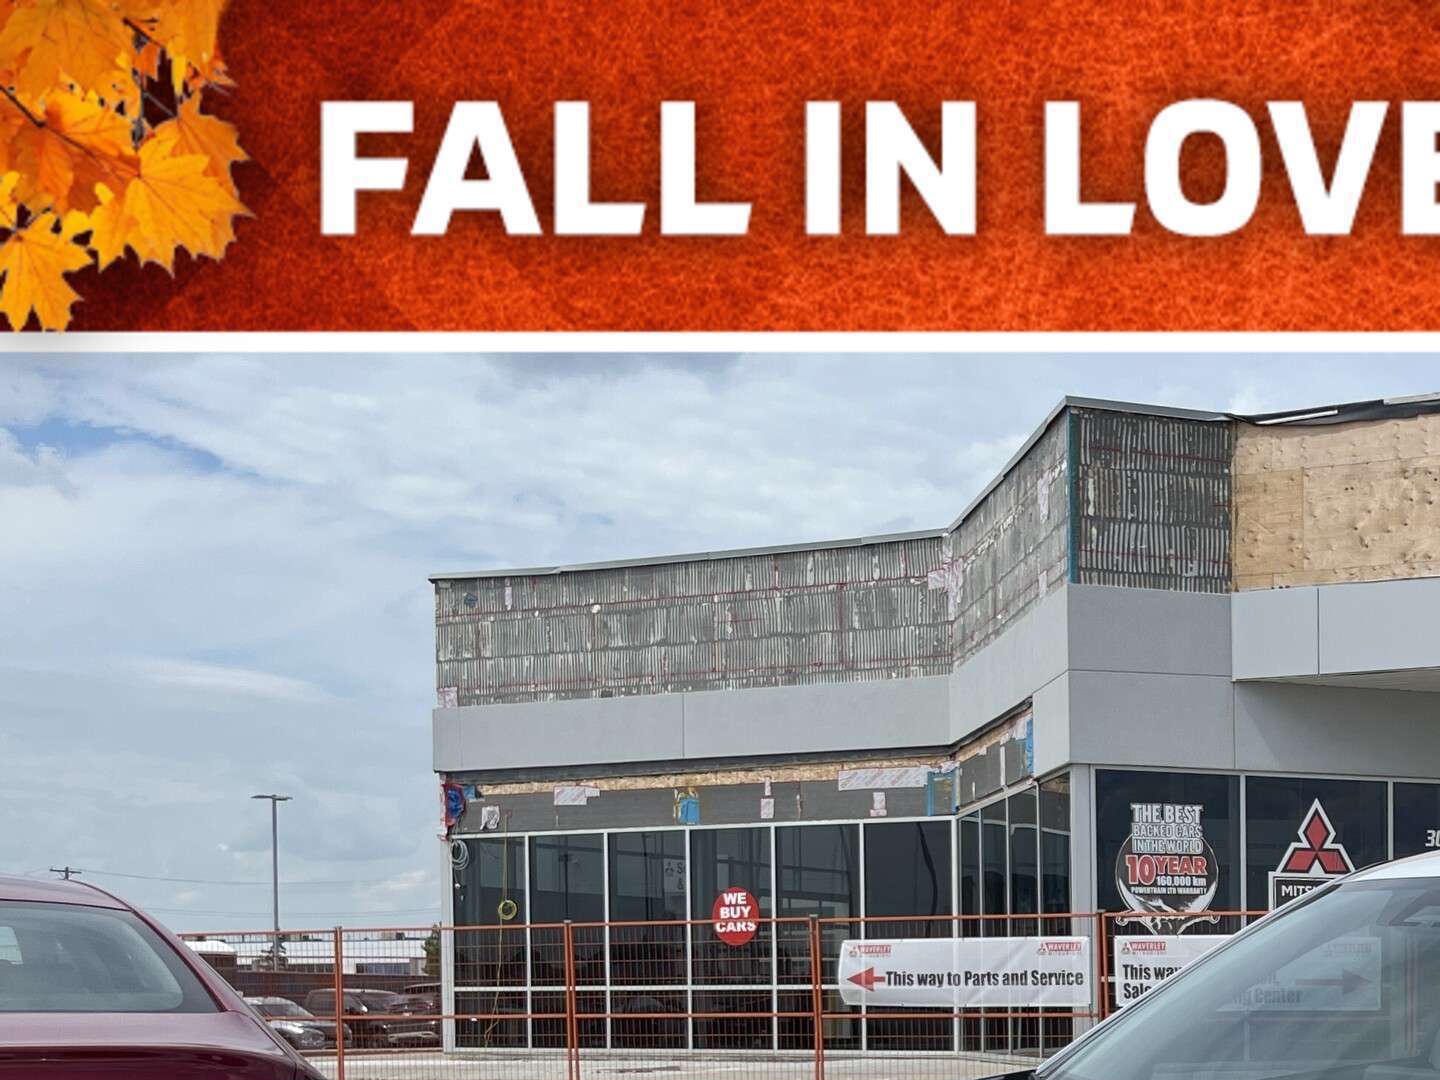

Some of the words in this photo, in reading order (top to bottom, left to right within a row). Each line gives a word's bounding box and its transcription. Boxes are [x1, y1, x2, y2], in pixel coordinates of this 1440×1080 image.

[1132, 805, 1161, 823] THE
[1163, 805, 1202, 824] BEST
[1132, 824, 1174, 838] BACKED
[1175, 825, 1203, 839] CARS
[1132, 839, 1145, 853] IN
[1145, 839, 1166, 853] THE
[1166, 839, 1203, 854] WORLD
[1125, 855, 1156, 886] 10
[1154, 856, 1208, 875] YEAR
[1281, 885, 1321, 896] MITS
[723, 893, 747, 905] WE
[720, 906, 751, 919] BUY
[716, 921, 757, 933] CARS
[886, 971, 914, 987] This
[917, 974, 944, 989] way
[947, 972, 961, 986] to
[965, 970, 999, 986] Parts
[1002, 969, 1028, 986] and
[1031, 969, 1084, 986] Service
[1122, 964, 1151, 980] This
